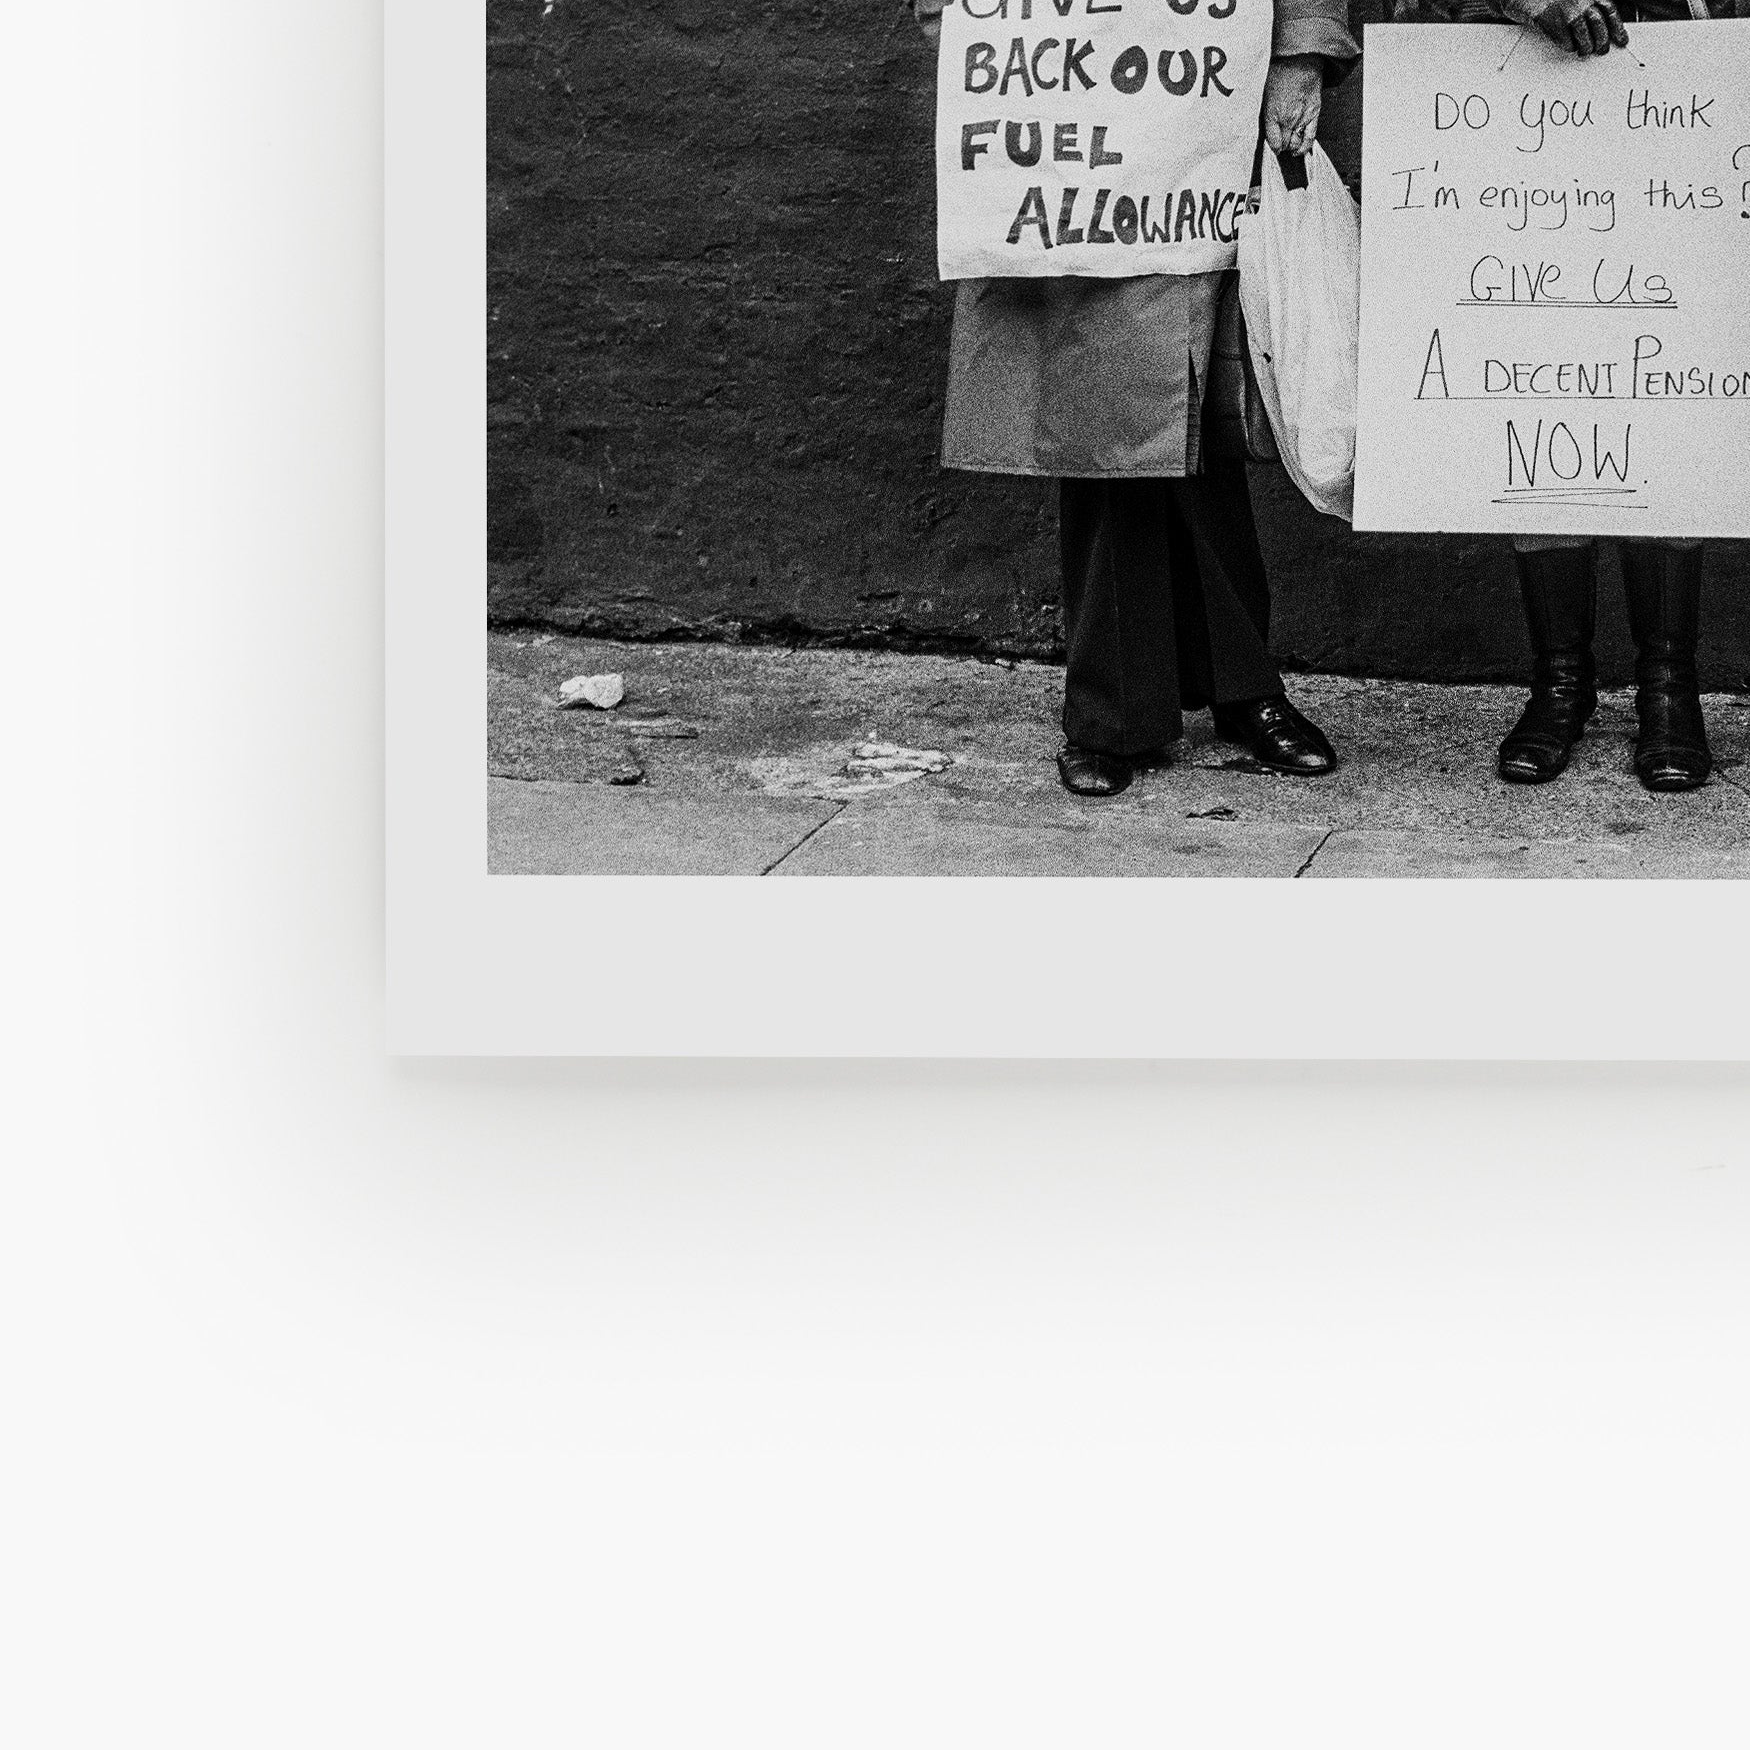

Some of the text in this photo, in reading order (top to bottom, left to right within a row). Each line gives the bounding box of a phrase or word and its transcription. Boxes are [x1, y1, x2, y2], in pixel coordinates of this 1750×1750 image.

[964, 37, 1234, 98] BACK OUR
[961, 119, 1123, 171] FUEL
[1516, 92, 1595, 152] you
[1005, 186, 1247, 249] ALLOWANCE
[1392, 160, 1460, 210] I'm
[1480, 178, 1616, 232] enjoying
[1418, 328, 1449, 398] A
[1484, 359, 1617, 395] DECENT
